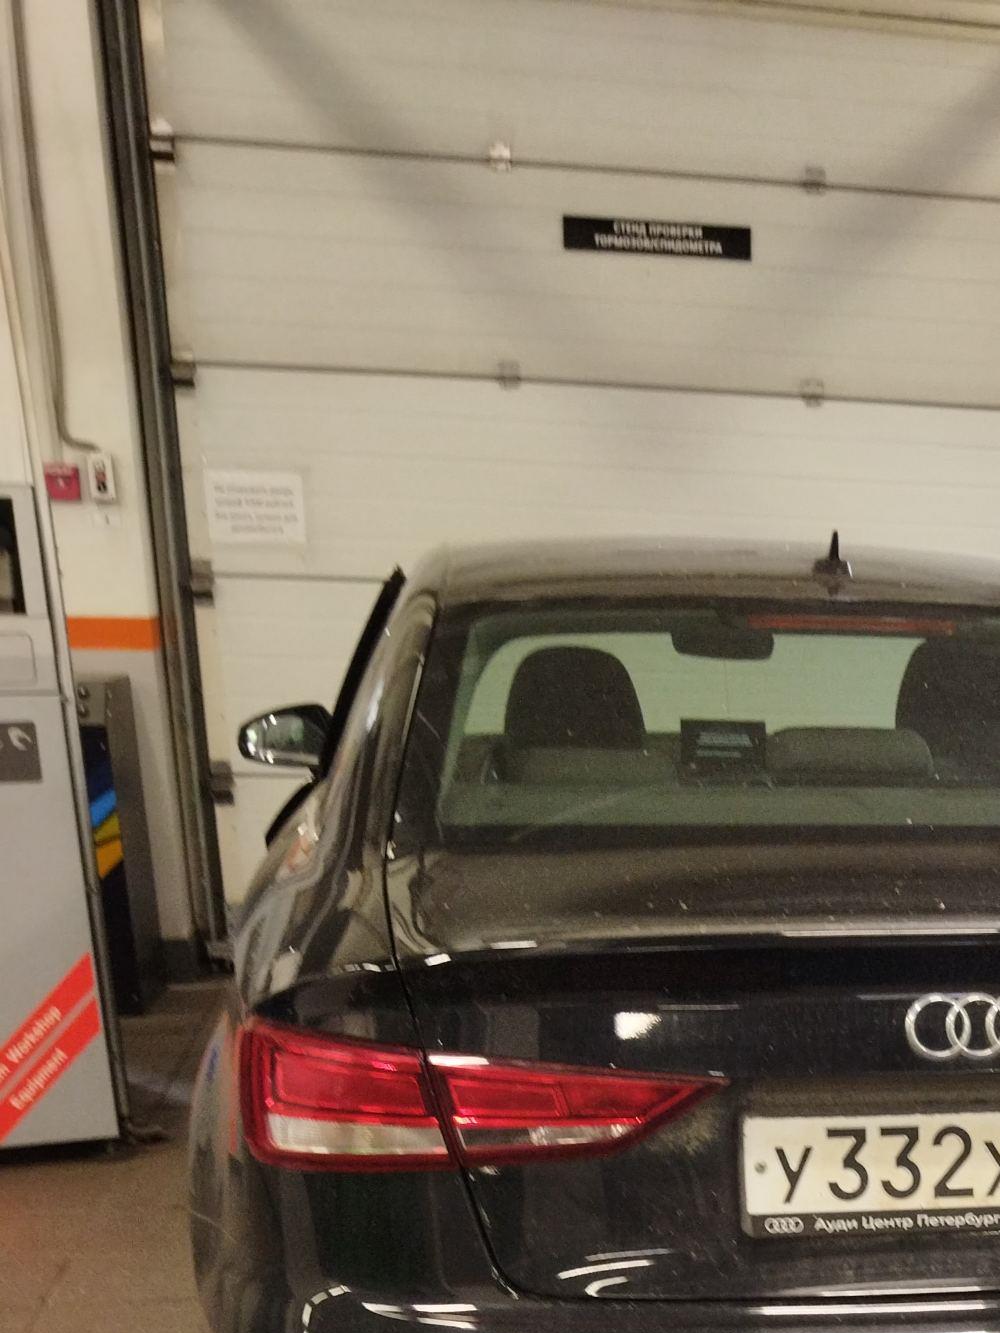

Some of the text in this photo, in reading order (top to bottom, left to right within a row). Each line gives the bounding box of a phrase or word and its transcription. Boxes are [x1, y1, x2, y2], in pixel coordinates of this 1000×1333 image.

[814, 1212, 1000, 1233] Ауди Центр Петербург
